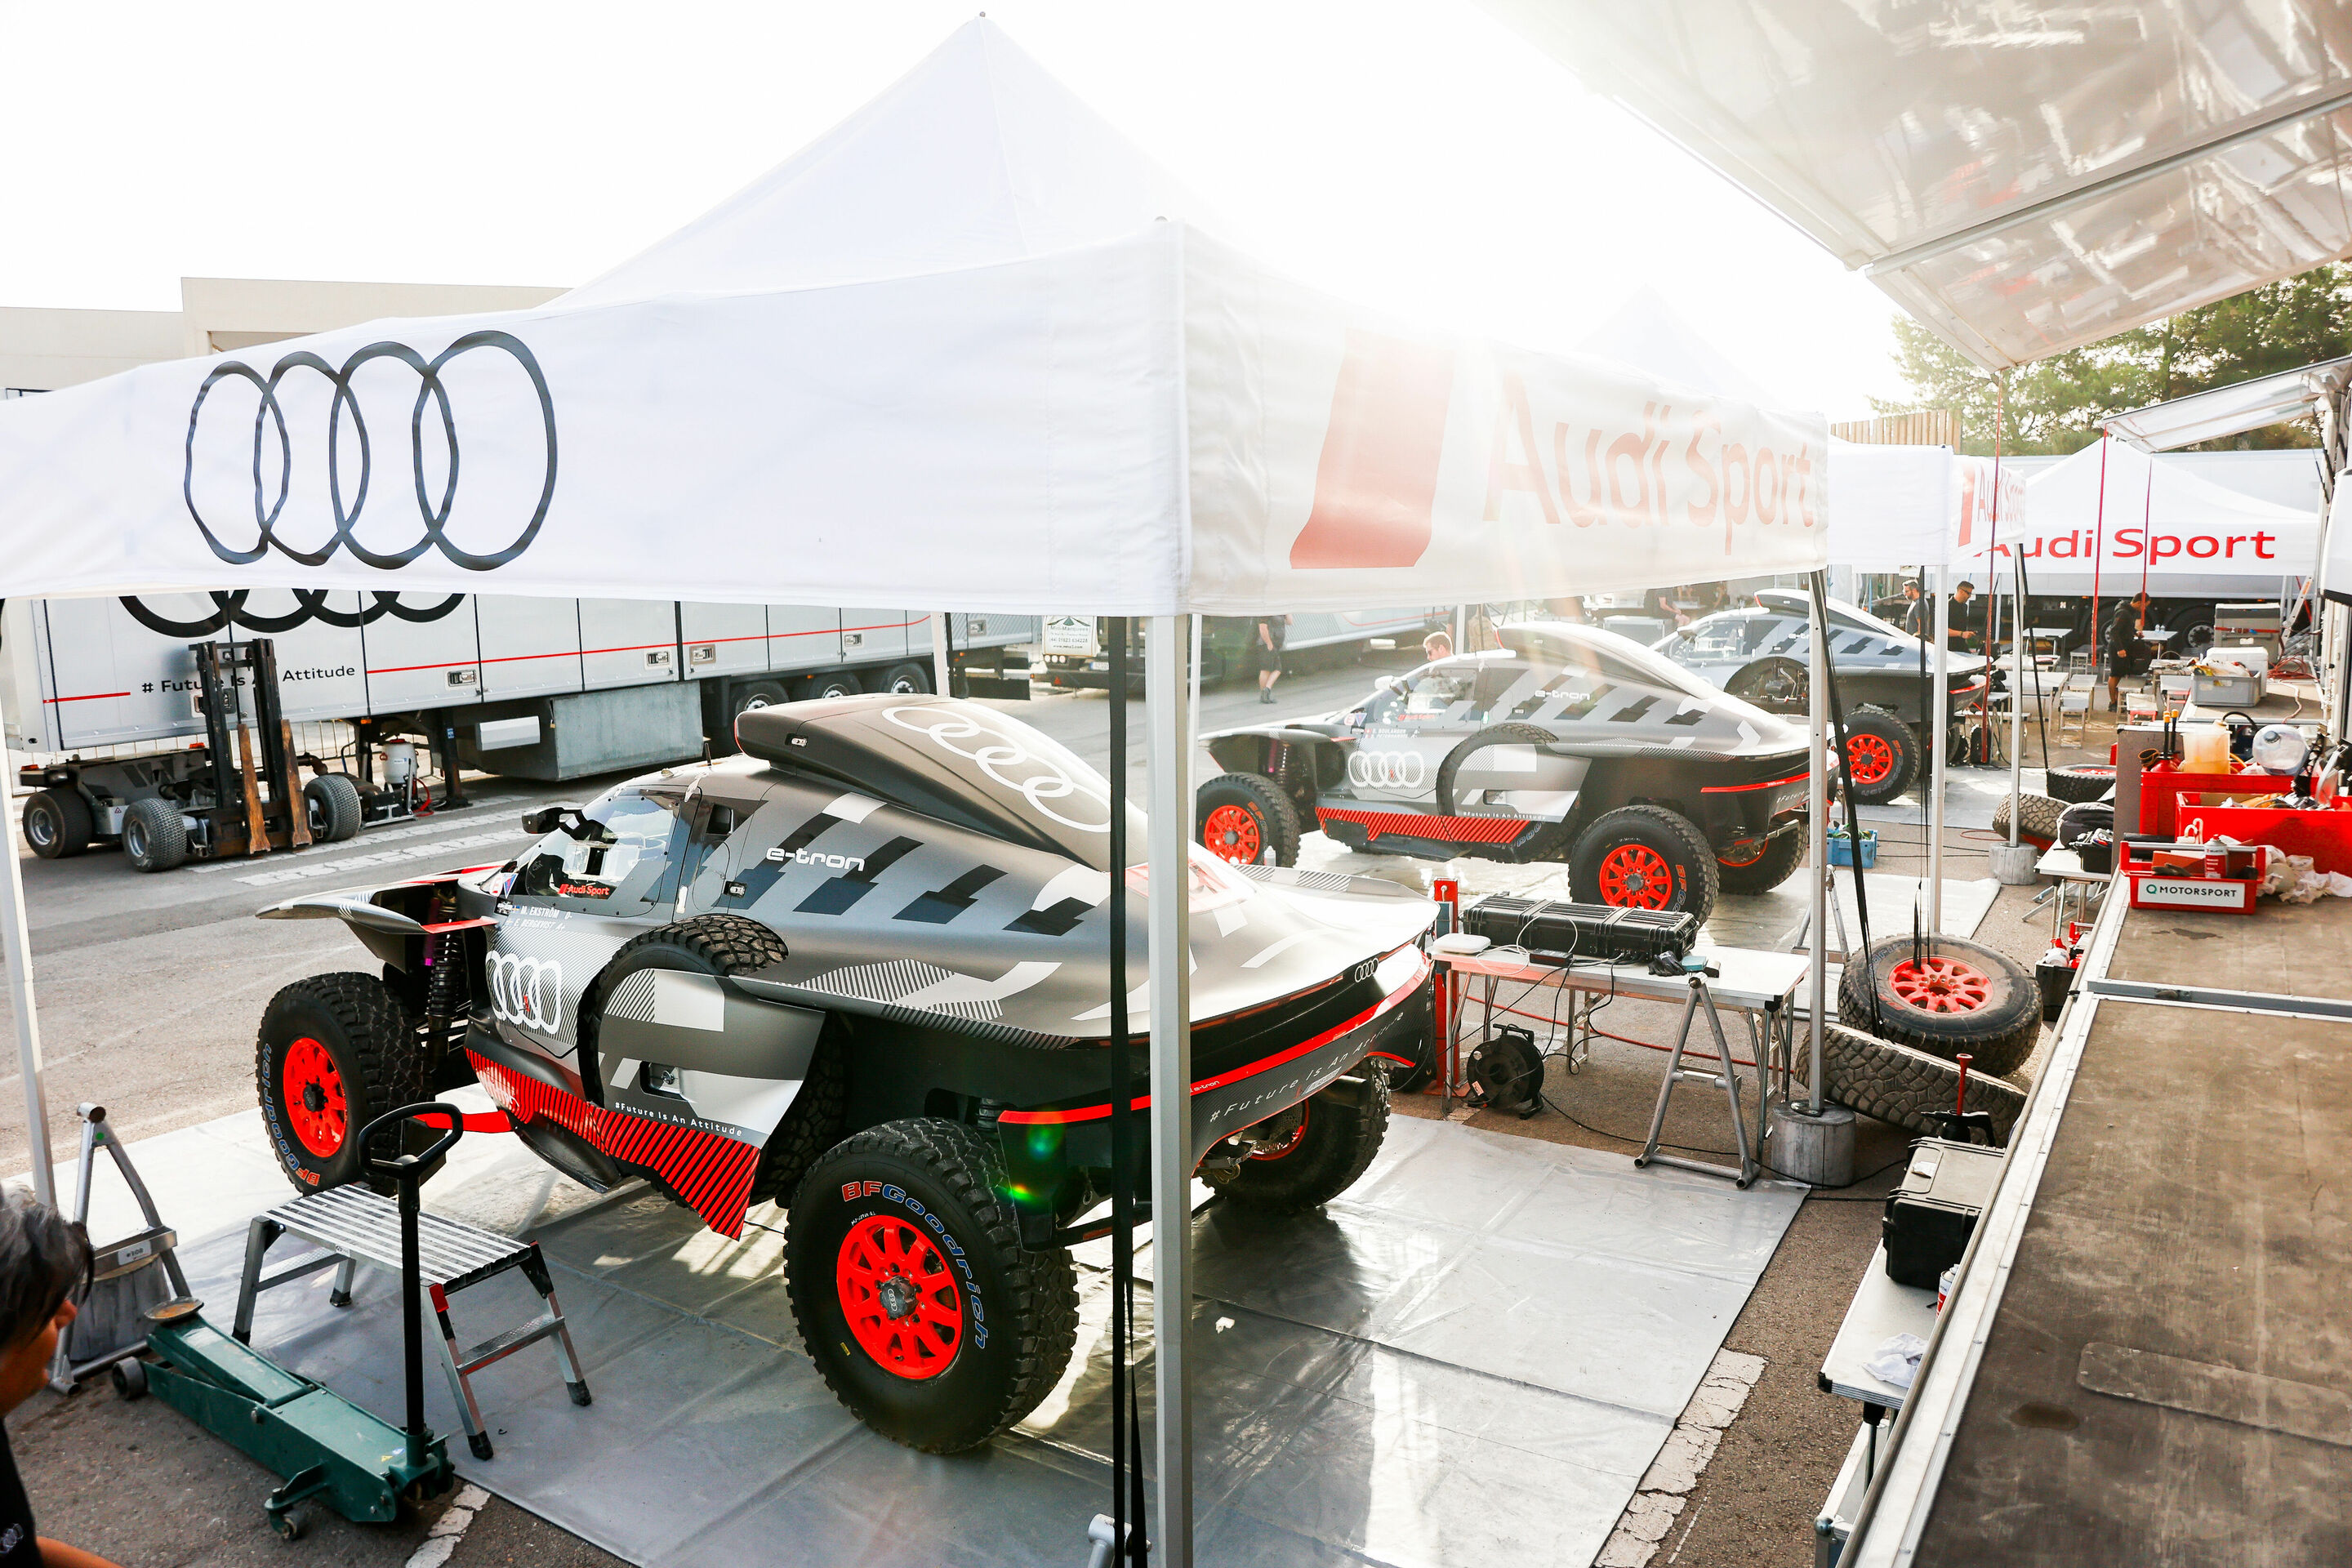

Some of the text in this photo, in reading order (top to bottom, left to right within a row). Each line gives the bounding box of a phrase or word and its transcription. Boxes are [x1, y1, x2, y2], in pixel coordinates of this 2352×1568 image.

[1482, 367, 1814, 555] Audi Sport
[2112, 528, 2275, 565] Sport
[230, 675, 246, 687] Is
[282, 665, 355, 681] Attitude
[1535, 689, 1591, 701] e-tron
[765, 846, 866, 871] e-tron
[568, 884, 610, 896] Audi Sport
[2159, 886, 2237, 897] MOTORSPORT
[1194, 1080, 1221, 1092] e-tron
[1209, 1079, 1299, 1122] #Future
[1305, 1067, 1323, 1081] Is
[1327, 1052, 1349, 1069] An
[262, 1042, 321, 1187] BFGoodrich
[615, 1102, 743, 1136] #Future Is An Attitude
[841, 1180, 989, 1349] BFGoodrich
